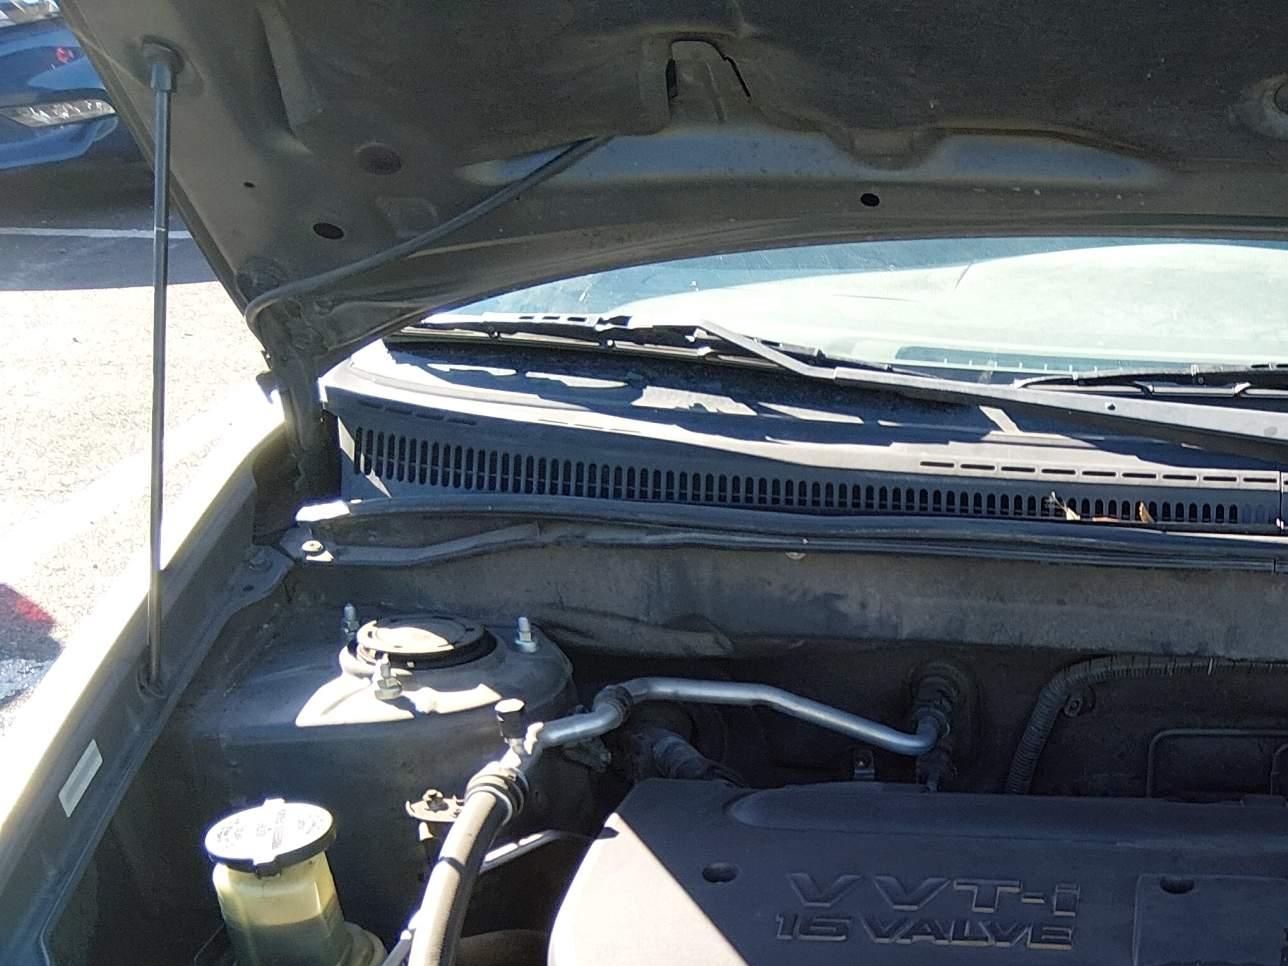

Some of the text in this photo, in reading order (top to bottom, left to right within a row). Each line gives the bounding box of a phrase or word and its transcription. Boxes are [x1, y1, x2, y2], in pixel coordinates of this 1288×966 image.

[786, 871, 1081, 918] VVT-i
[775, 911, 1076, 951] 16 VALVE
